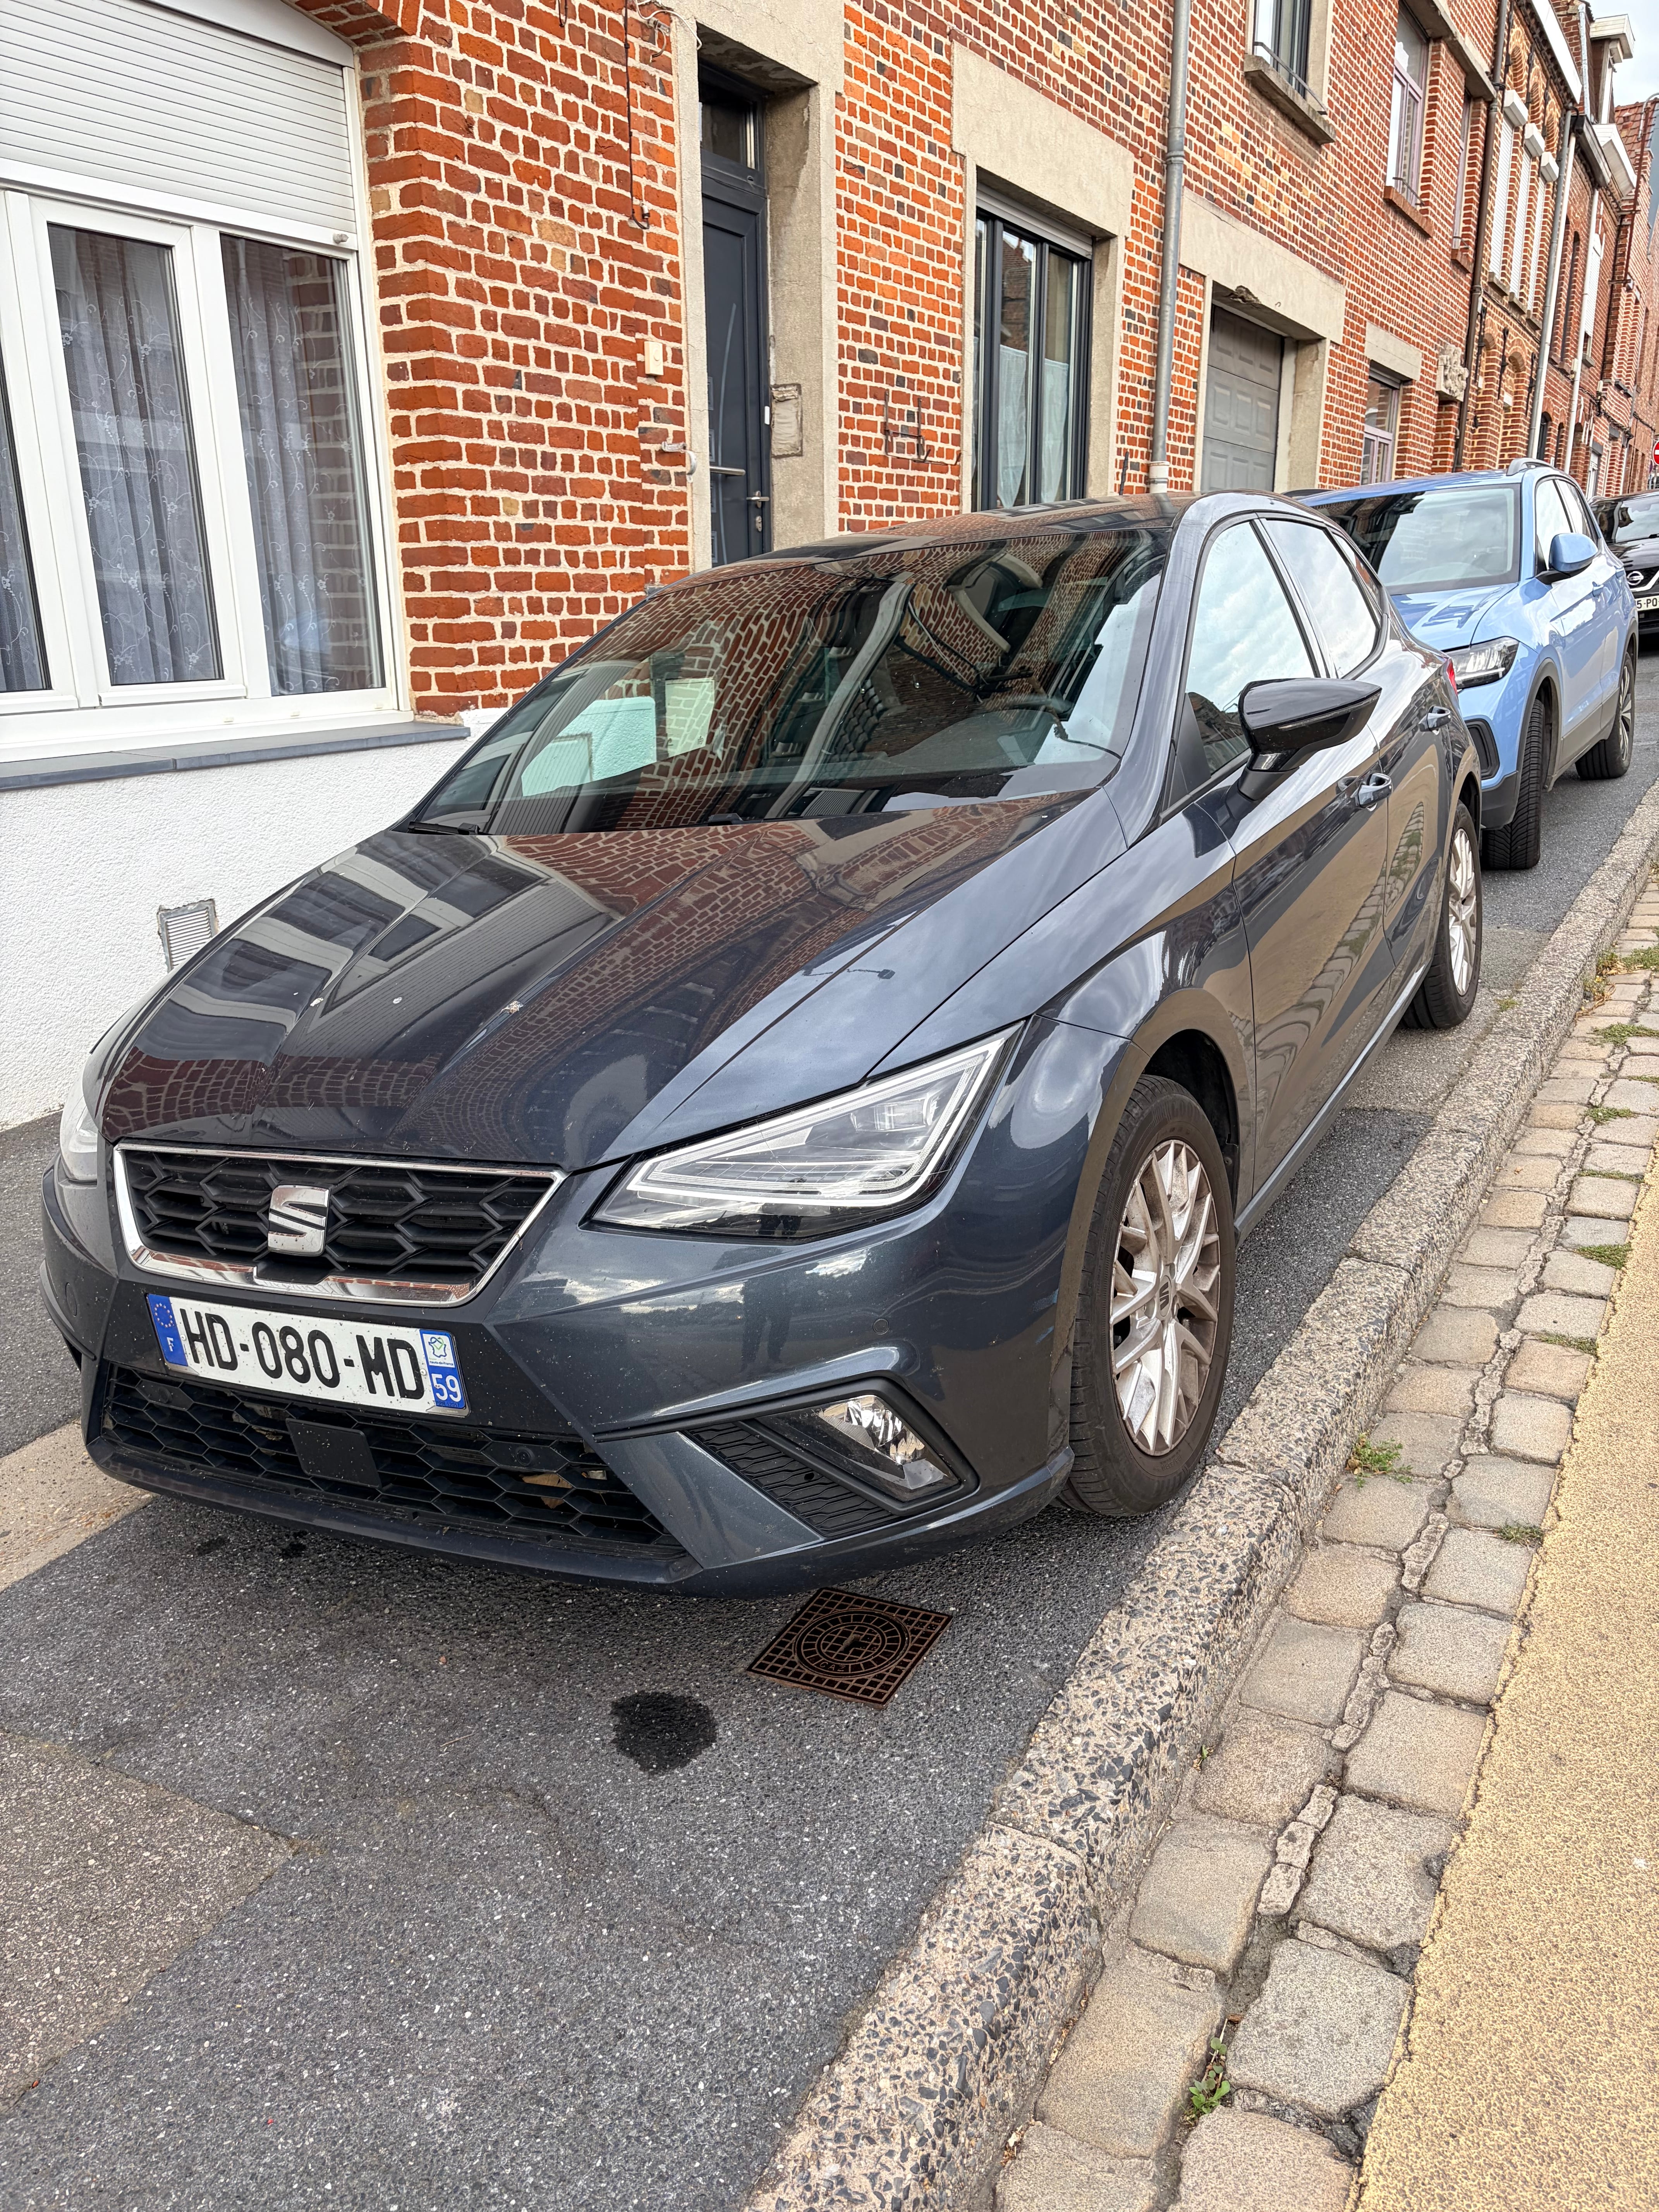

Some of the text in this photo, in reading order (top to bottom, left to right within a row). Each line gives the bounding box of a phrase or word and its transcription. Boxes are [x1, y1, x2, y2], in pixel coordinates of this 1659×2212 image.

[167, 1337, 174, 1352] F
[179, 1308, 426, 1400] HD-080-MD
[431, 1373, 462, 1402] 59
